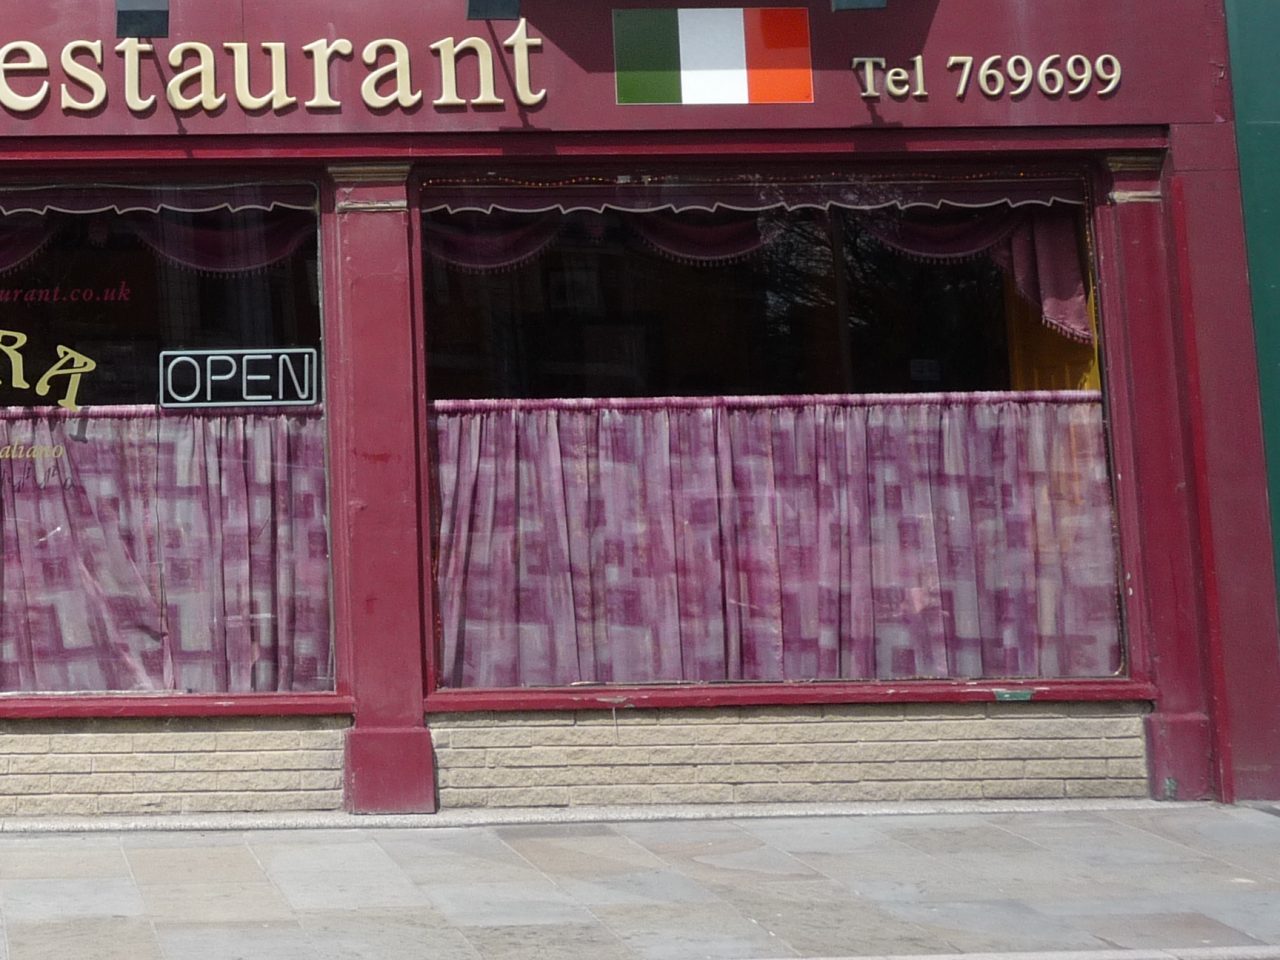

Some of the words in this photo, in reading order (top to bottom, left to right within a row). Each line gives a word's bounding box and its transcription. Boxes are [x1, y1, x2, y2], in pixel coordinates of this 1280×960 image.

[851, 55, 929, 98] Tel
[946, 54, 1121, 97] 769699
[166, 353, 310, 402] OPEN
